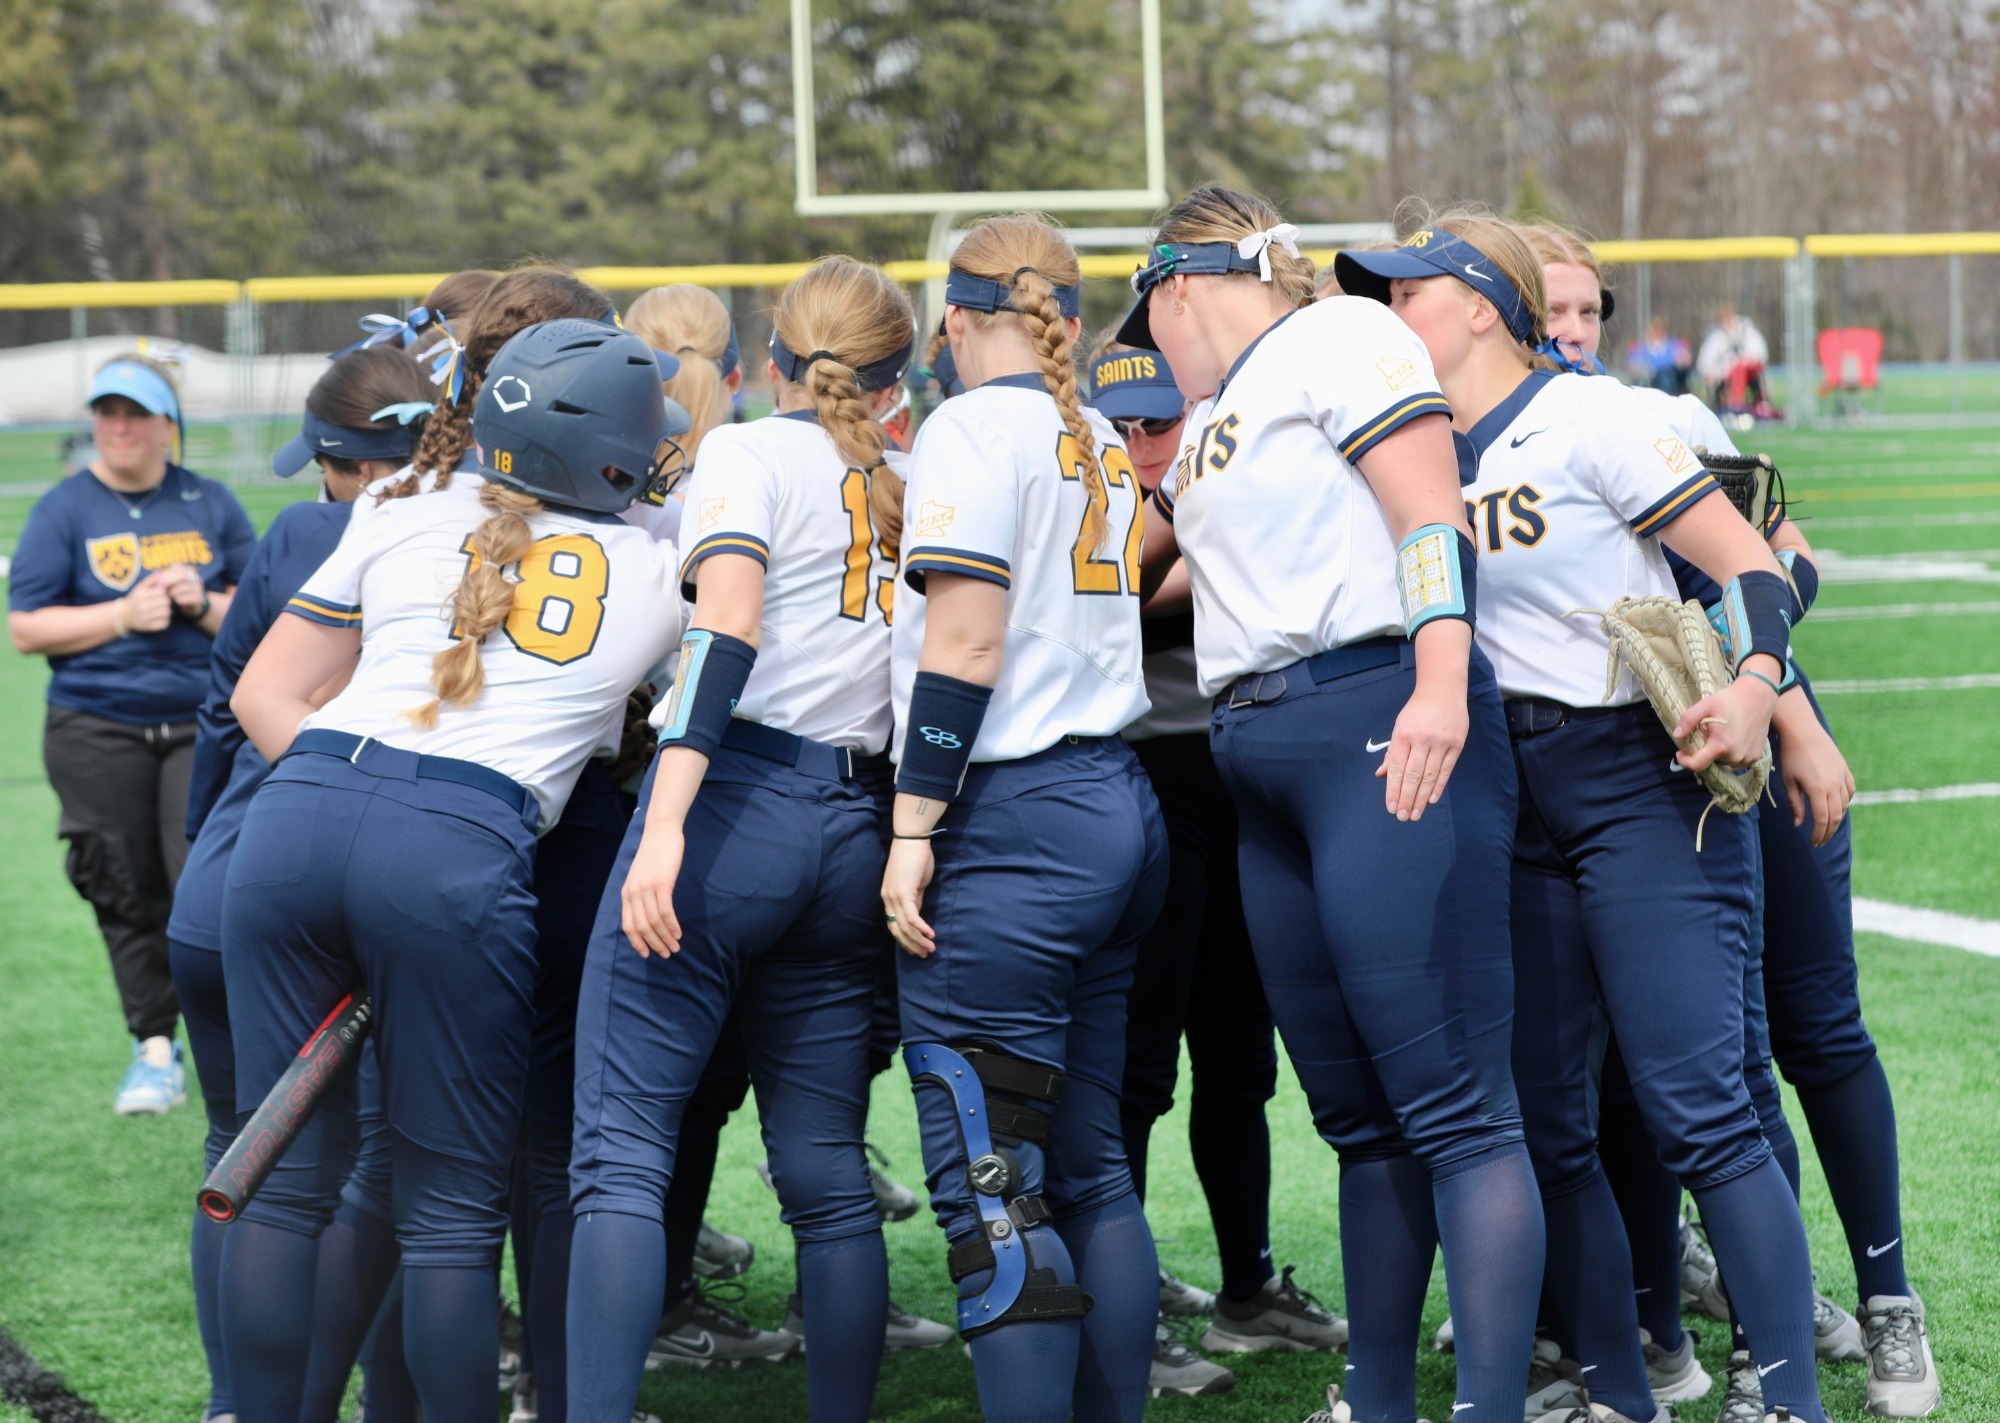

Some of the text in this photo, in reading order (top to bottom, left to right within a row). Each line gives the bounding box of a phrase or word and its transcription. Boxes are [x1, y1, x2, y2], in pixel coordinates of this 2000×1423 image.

[1096, 356, 1157, 388] SAINTS
[493, 449, 513, 474] 18
[1055, 430, 1145, 597] 22
[230, 1034, 345, 1198] EASTON
